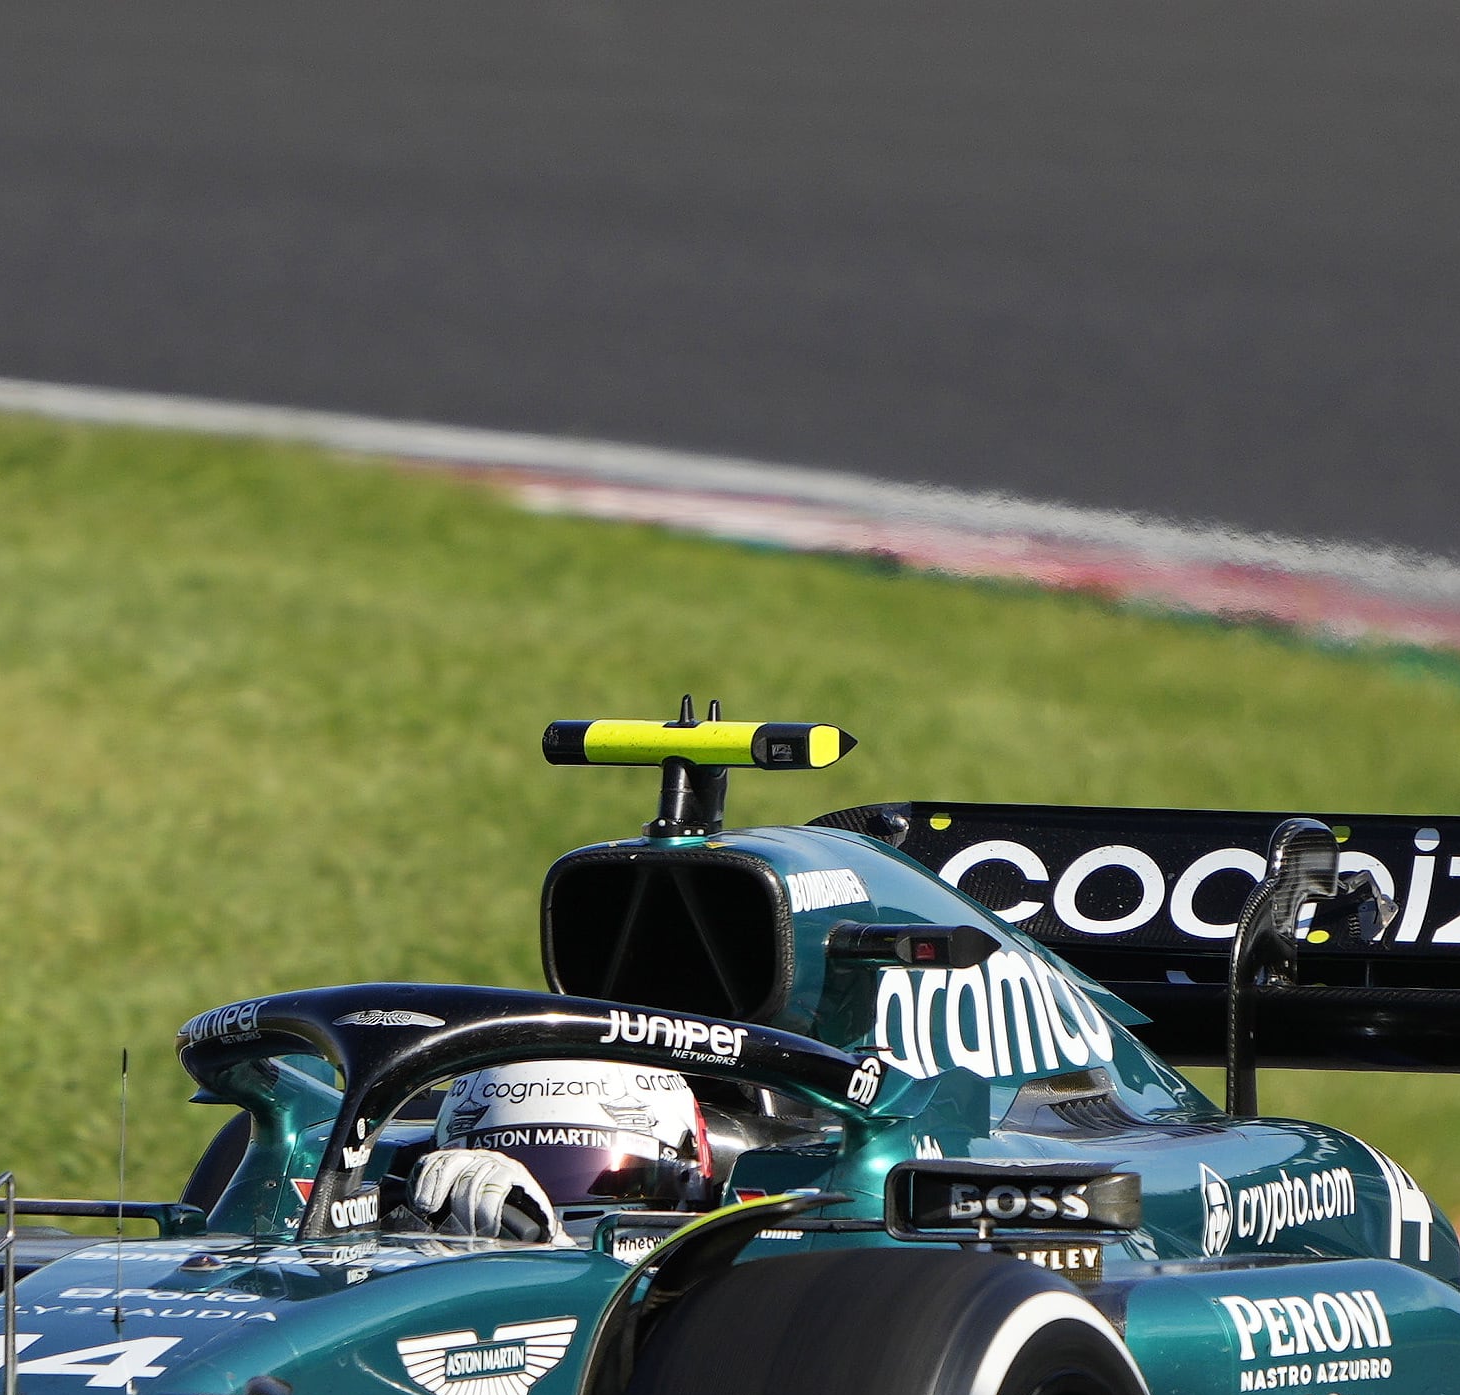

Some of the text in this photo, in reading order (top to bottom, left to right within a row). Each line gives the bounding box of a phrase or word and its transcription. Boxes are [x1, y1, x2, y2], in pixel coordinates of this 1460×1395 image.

[785, 868, 870, 914] BOMBARDIER
[874, 950, 1114, 1080] aramco
[670, 1048, 739, 1066] NETWORKS
[482, 1078, 610, 1104] cognizant
[635, 1072, 687, 1091] aram
[474, 1129, 530, 1151] ASTON
[534, 1128, 612, 1148] MARTIN
[331, 1194, 378, 1229] aramco
[950, 1182, 1090, 1221] BOSS
[1237, 1168, 1357, 1246] crypto.com
[72, 1252, 418, 1268] BOMARDIER
[1018, 1247, 1099, 1270] KLEY
[113, 1287, 262, 1303] Porto
[96, 1306, 278, 1323] SAUDIA
[1219, 1290, 1392, 1361] PERONI
[445, 1345, 526, 1377] ASTON MARTIN
[1240, 1357, 1392, 1392] NASTRO AZZURRO
